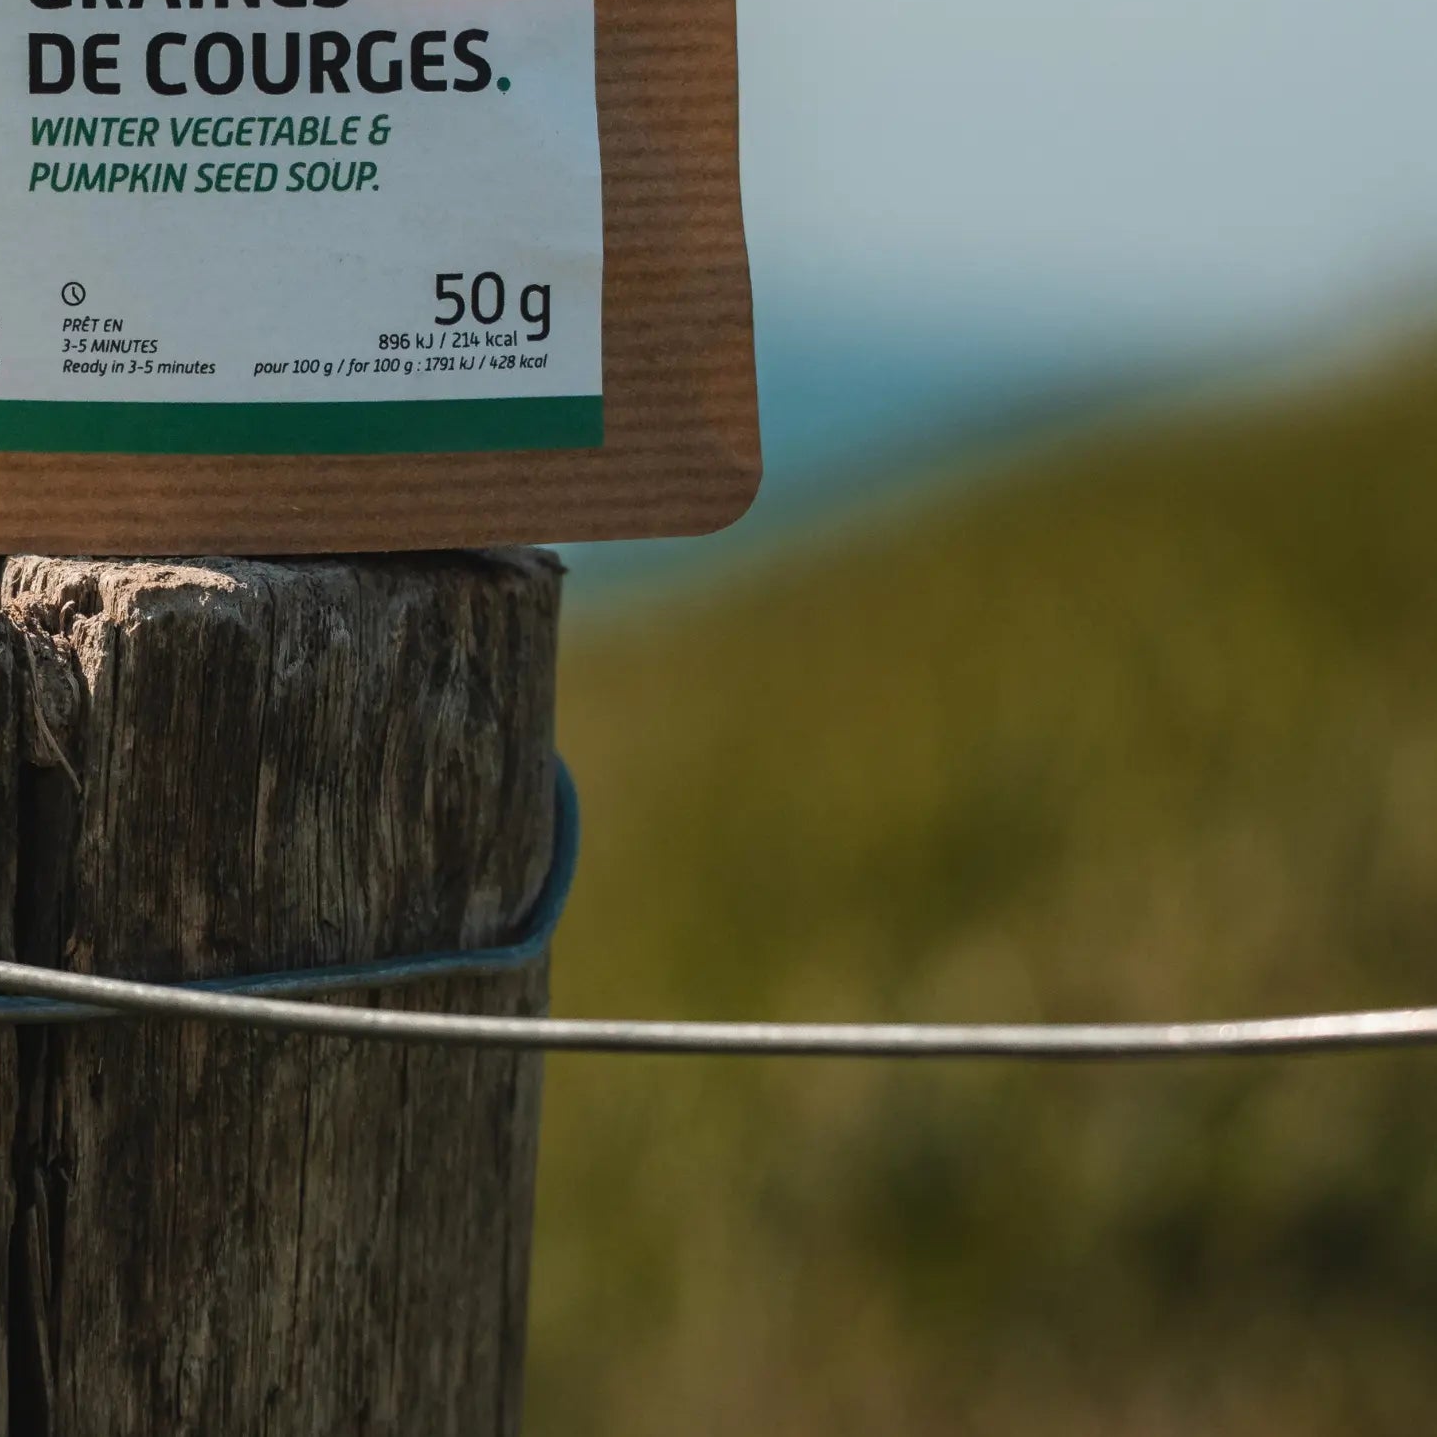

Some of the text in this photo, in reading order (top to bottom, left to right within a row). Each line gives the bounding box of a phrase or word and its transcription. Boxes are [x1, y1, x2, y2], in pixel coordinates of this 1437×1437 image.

[28, 28, 511, 95] DE COURGES.
[30, 113, 392, 147] WINTER VEGETABLE &
[28, 160, 381, 193] PUMPKIN SEED SOUP.
[434, 271, 551, 341] 50 g
[62, 315, 124, 333] PRÊT EN
[61, 338, 159, 354] 3-5 MINUTES
[378, 330, 518, 350] 896 kJ / 214 kcal
[62, 359, 216, 377] Ready in 3-5 minutes
[253, 361, 290, 376] pour
[293, 358, 321, 374] 100
[323, 361, 334, 376] g
[336, 358, 346, 374] /
[346, 358, 371, 377] for
[374, 357, 401, 373] 100
[403, 360, 414, 375] g
[425, 356, 455, 371] 1791
[459, 355, 477, 371] kJ
[478, 355, 487, 370] /
[489, 354, 516, 370] 428
[519, 353, 548, 369] kcal
